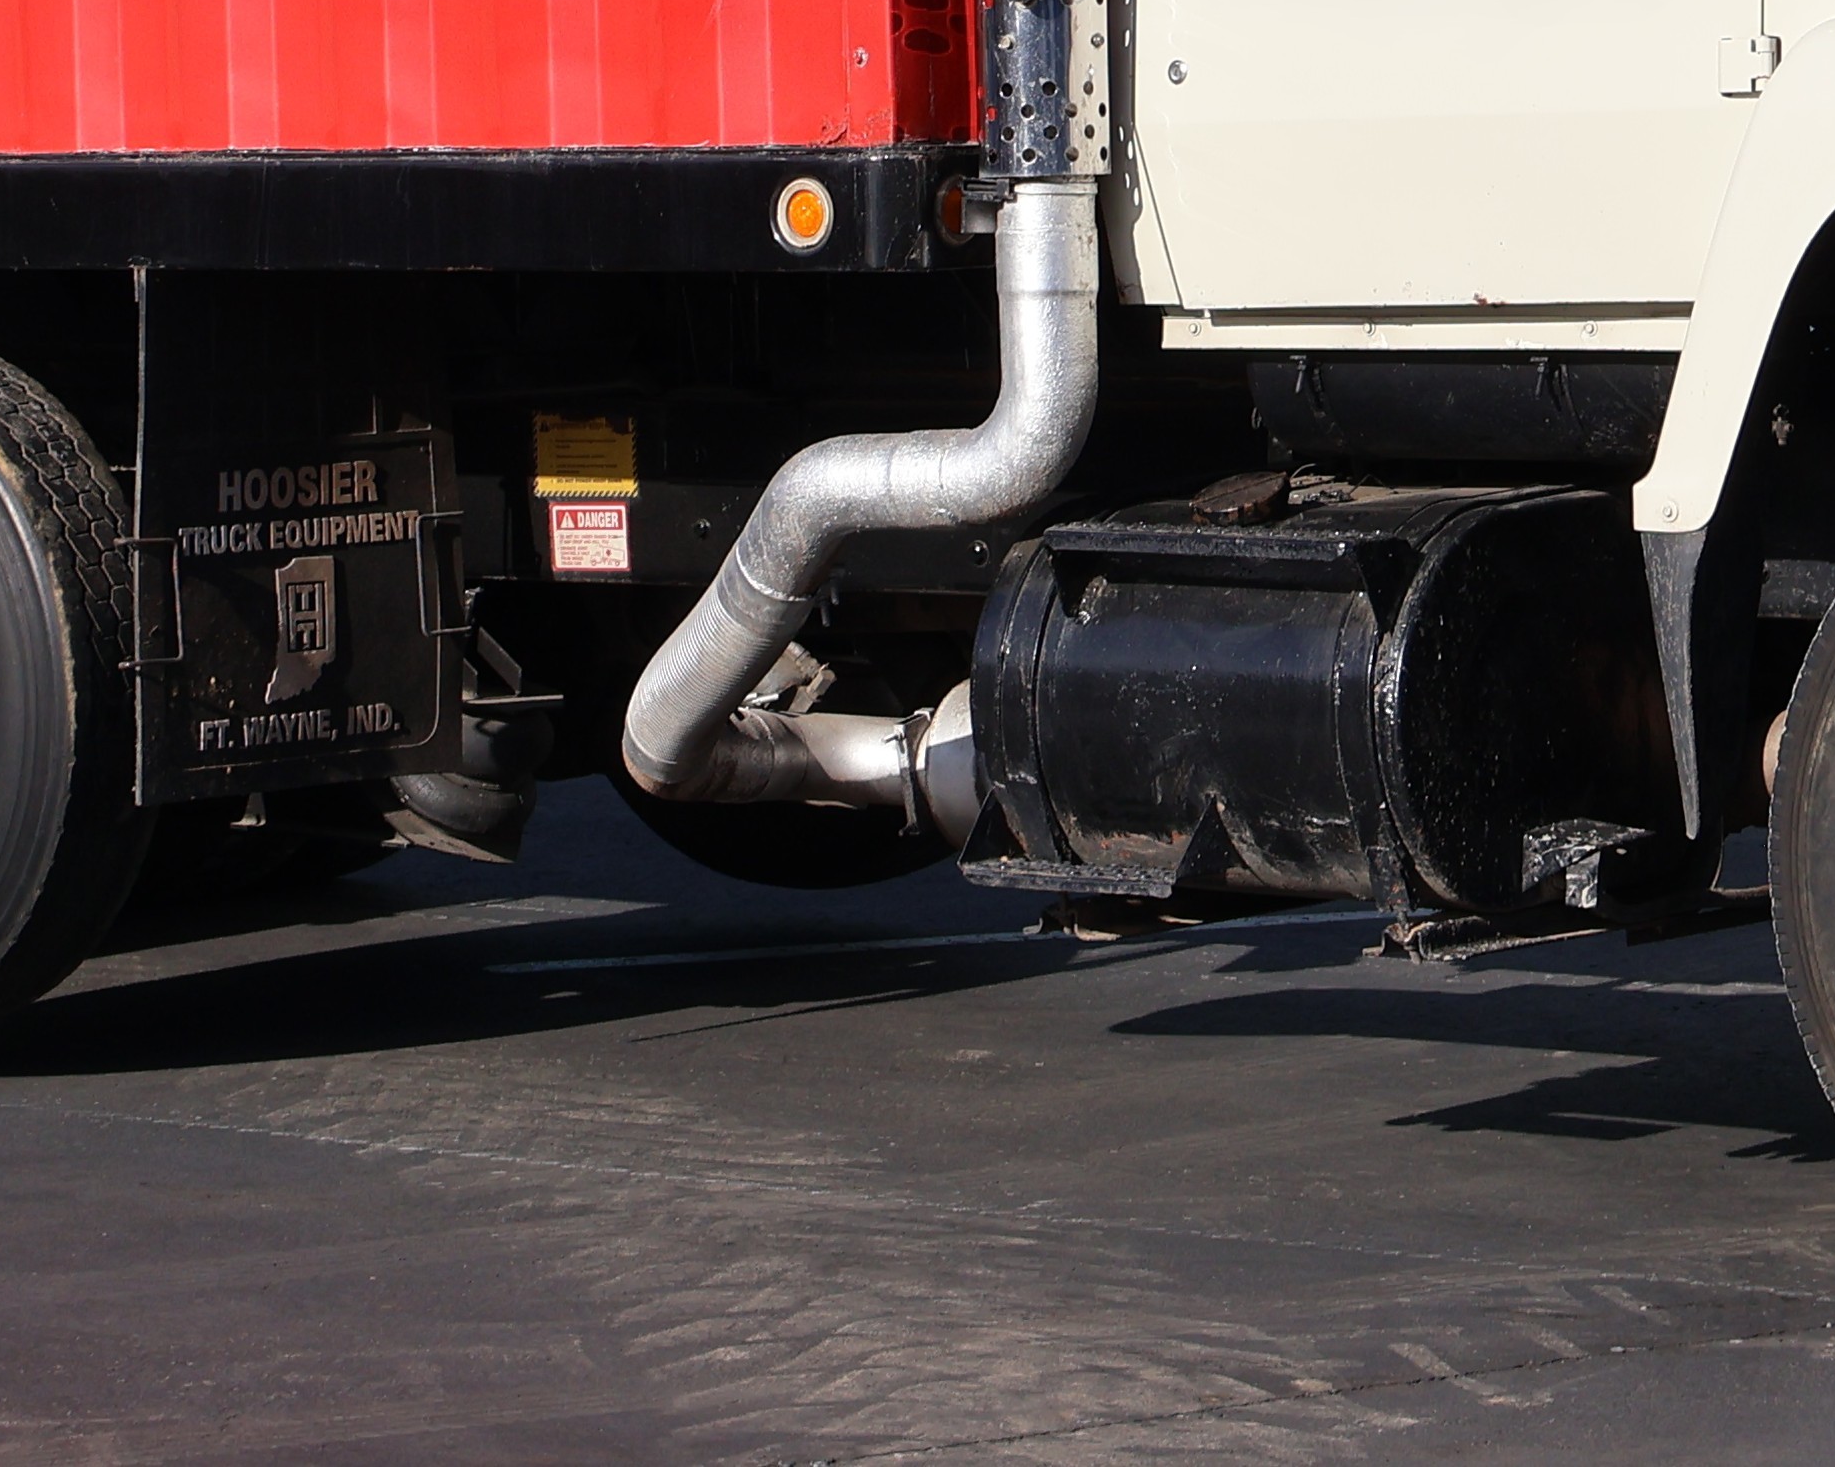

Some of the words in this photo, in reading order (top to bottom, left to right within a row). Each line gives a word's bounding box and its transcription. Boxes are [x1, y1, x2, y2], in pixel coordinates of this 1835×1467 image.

[218, 459, 379, 514] HOOSIER
[178, 520, 264, 557] TRUCK
[269, 509, 419, 550] EQUIPMENT
[577, 511, 619, 528] DANGER
[199, 718, 235, 752] FT.
[243, 708, 338, 749] WAYNE,
[346, 702, 401, 733] IND.
